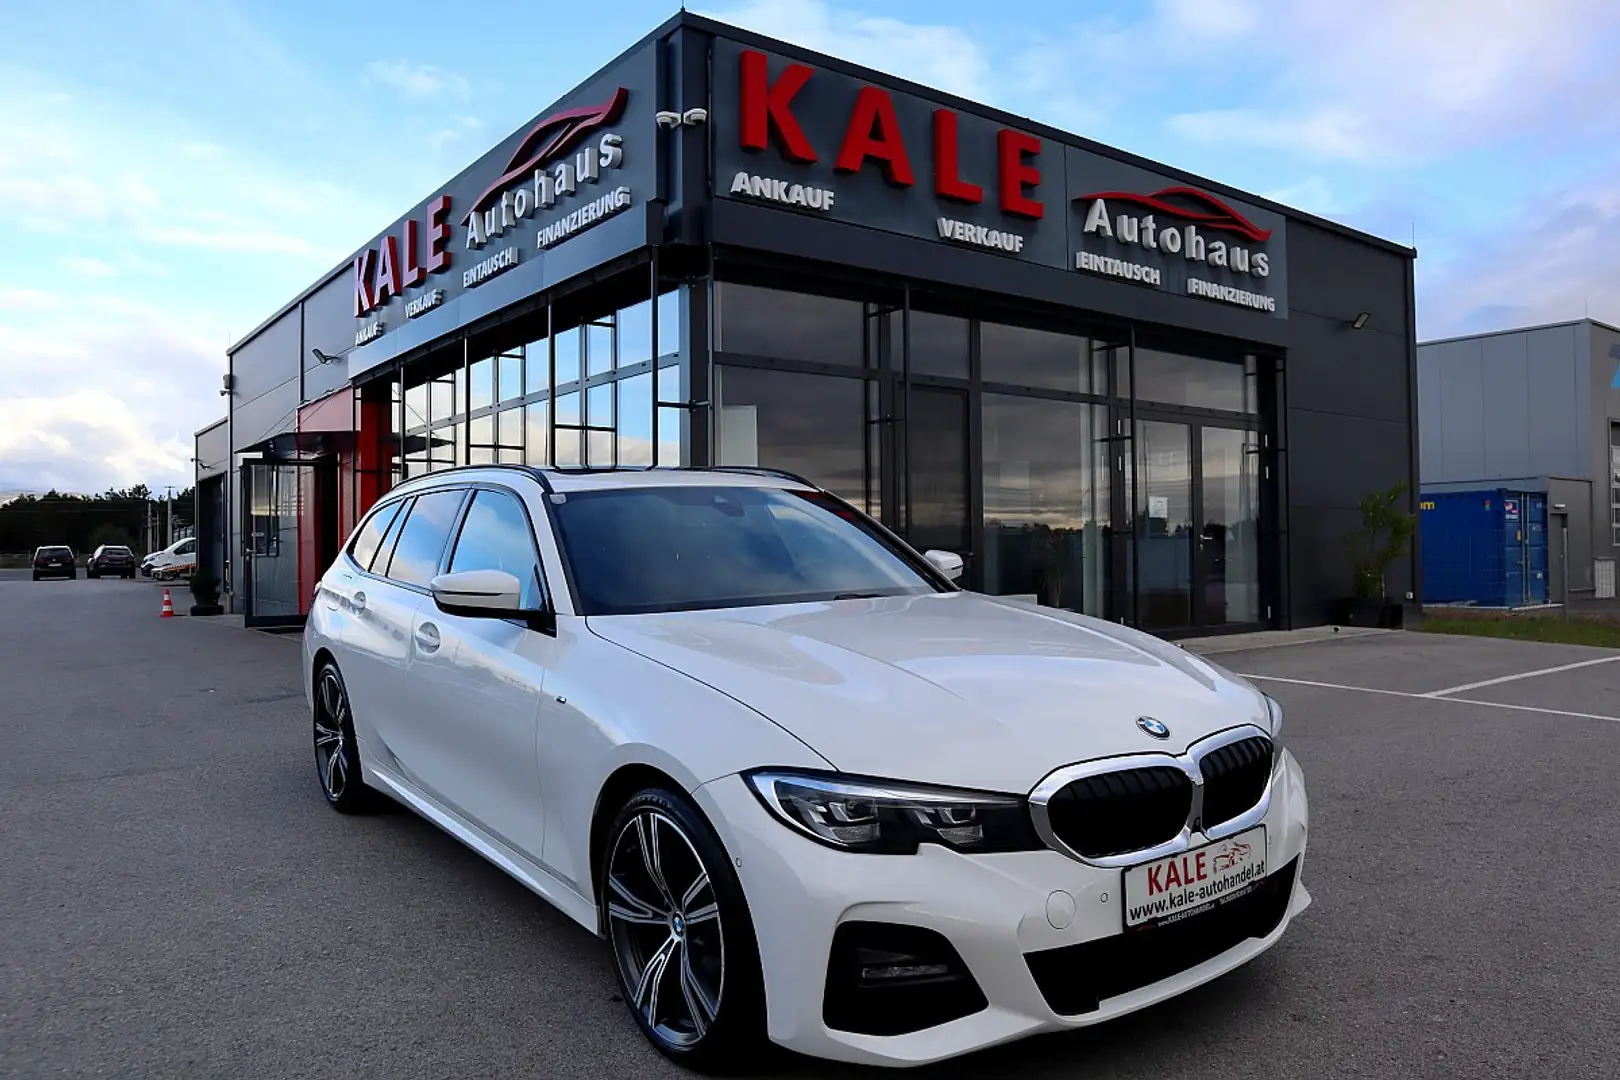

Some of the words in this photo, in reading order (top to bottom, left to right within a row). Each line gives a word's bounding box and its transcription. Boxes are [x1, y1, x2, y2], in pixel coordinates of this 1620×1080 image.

[739, 49, 1045, 220] KALE
[464, 132, 623, 250] Autohaus
[537, 186, 632, 249] FINANZIERUNG
[730, 171, 834, 212] ANKAUF
[353, 195, 452, 318] KALE
[936, 216, 1024, 253] VERKAUF
[1082, 198, 1270, 278] Autohaus
[463, 247, 518, 288] EINTAUSCH
[1075, 251, 1161, 286] EINTAUSCH
[1186, 278, 1276, 312] FINANZIERUNG
[1129, 859, 1266, 921] www.kale-autohandel.at
[1147, 851, 1208, 896] KALE
